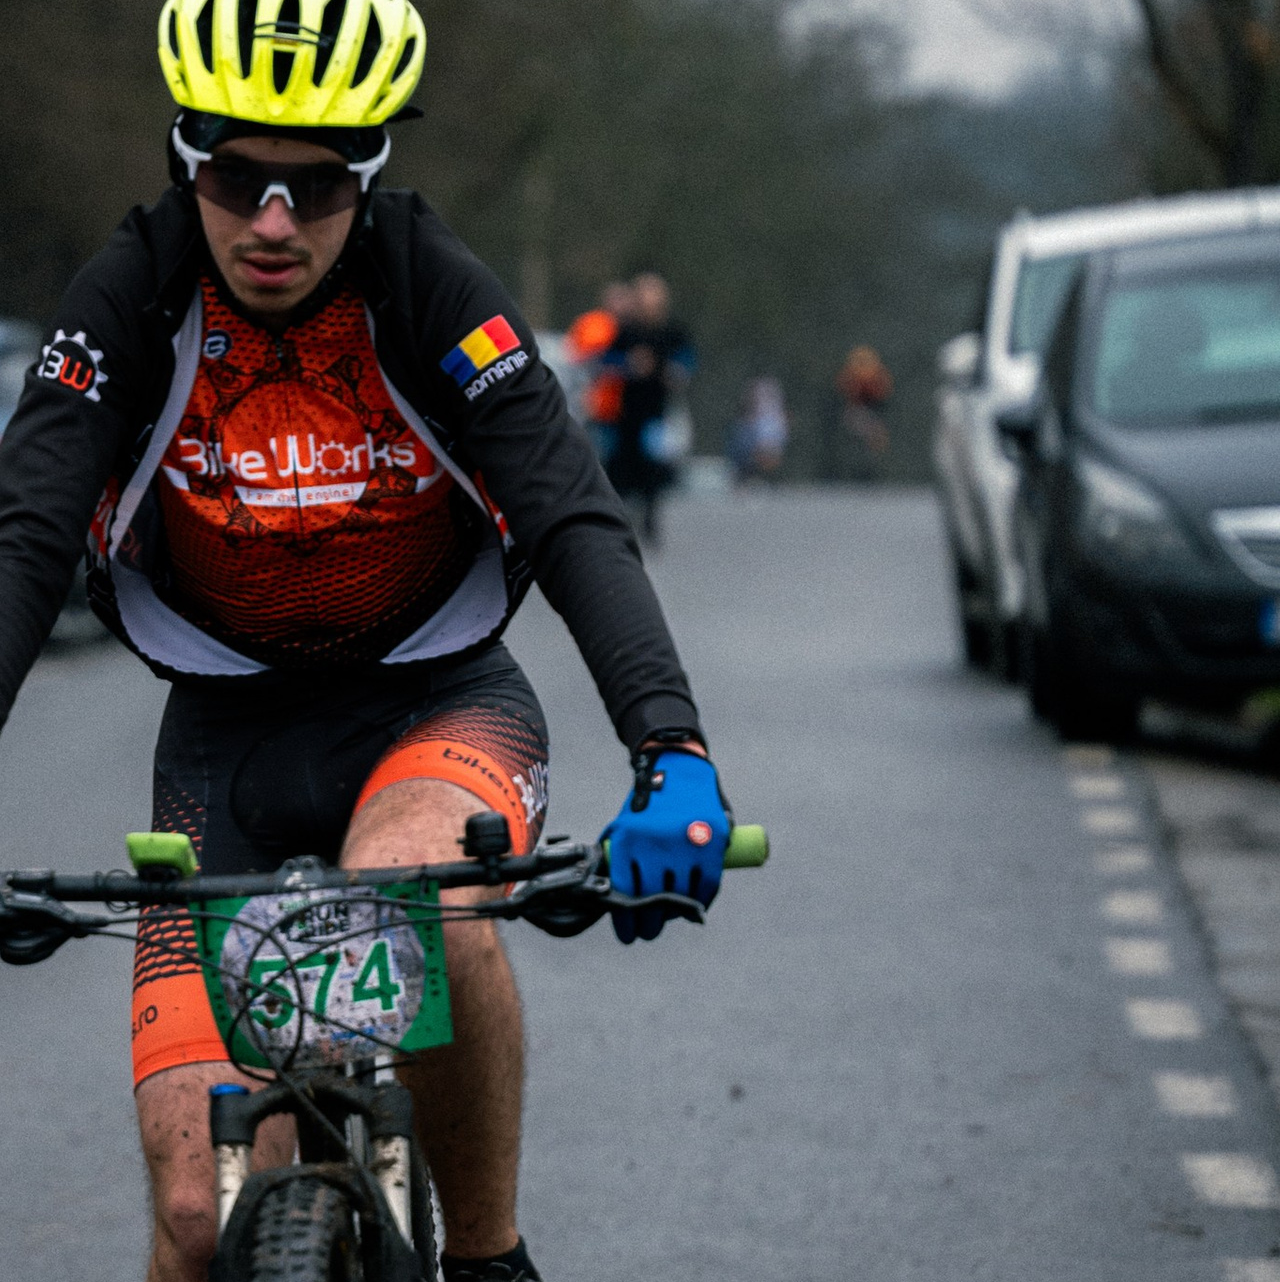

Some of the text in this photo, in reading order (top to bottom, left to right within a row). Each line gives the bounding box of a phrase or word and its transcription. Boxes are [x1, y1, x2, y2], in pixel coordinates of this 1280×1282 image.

[463, 350, 529, 402] ROMANIA
[178, 432, 417, 481] Bike Works
[305, 485, 356, 502] engine!
[247, 938, 403, 1031] 574
